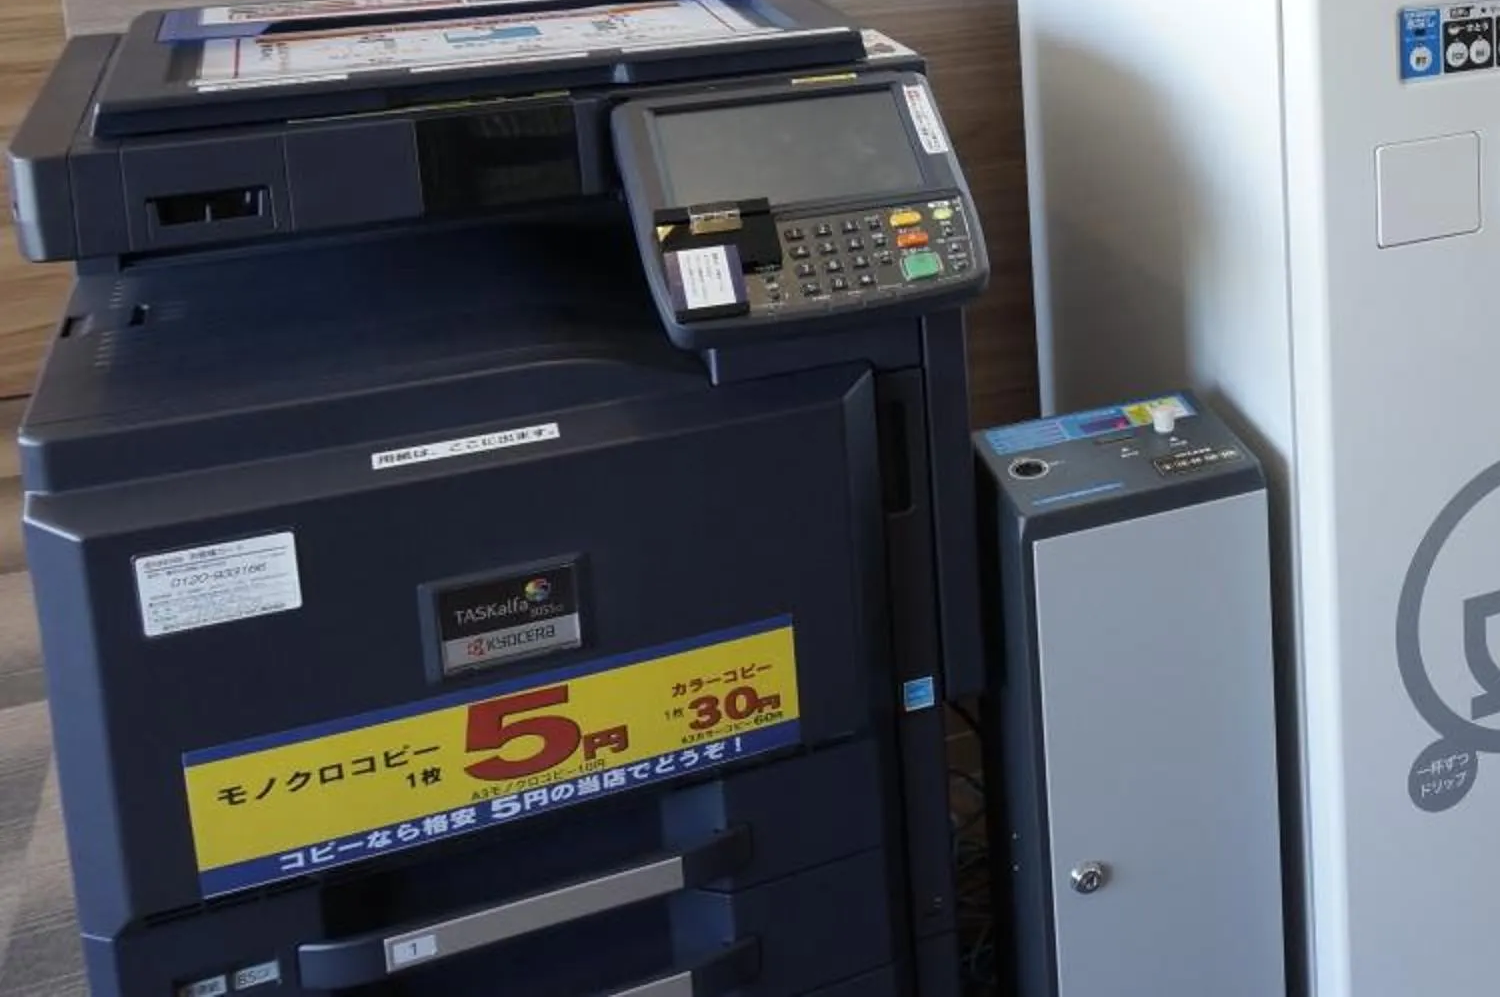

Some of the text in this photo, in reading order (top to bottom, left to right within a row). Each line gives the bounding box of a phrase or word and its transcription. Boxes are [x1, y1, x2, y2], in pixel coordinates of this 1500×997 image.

[455, 597, 529, 625] TASKalfa
[487, 625, 555, 651] KYOCERA
[672, 663, 772, 697] カラーコピー
[217, 745, 441, 806] モノクロコピー
[405, 767, 442, 789] 1枚
[279, 806, 477, 871] コピーなら格安
